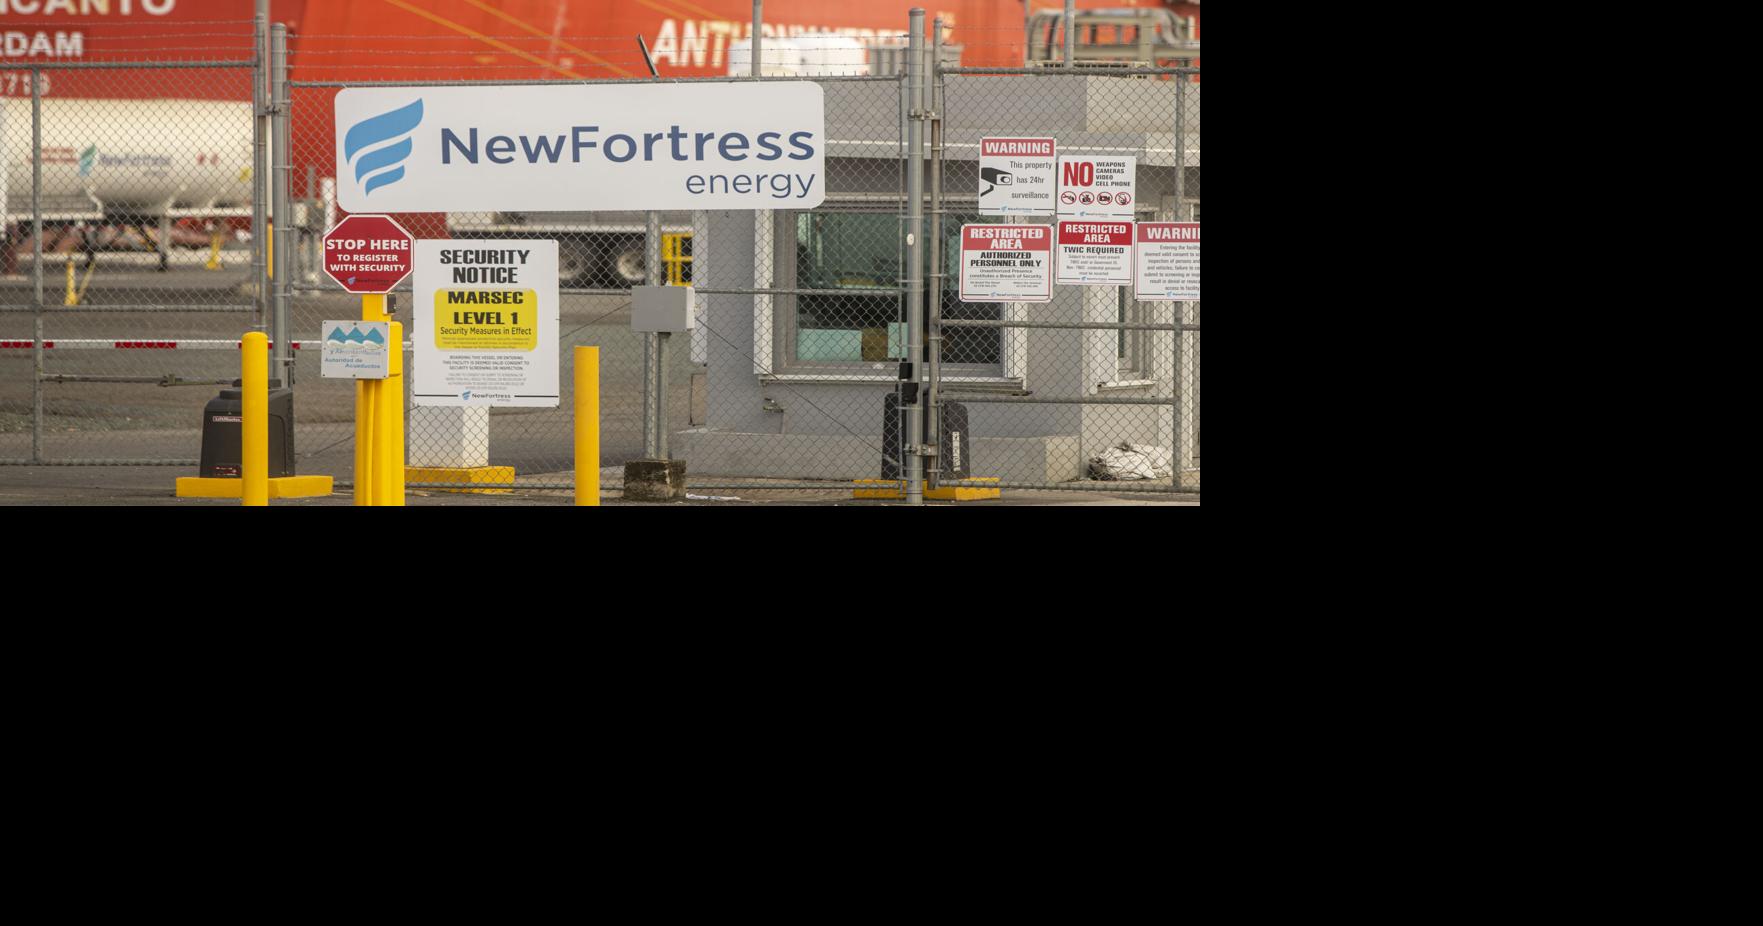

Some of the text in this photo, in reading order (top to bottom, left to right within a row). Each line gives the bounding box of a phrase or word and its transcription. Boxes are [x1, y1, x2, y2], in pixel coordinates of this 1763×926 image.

[0, 31, 84, 57] DAM
[441, 125, 815, 164] NewFortress
[985, 142, 1050, 154] WARNING
[1010, 161, 1052, 170] This property
[1017, 176, 1045, 184] has 24hr
[1063, 162, 1094, 187] NO
[686, 172, 815, 198] energy
[970, 228, 1043, 239] RESTRICTED
[1065, 224, 1126, 234] RESTRICTED
[991, 239, 1023, 249] AREA
[1084, 234, 1111, 243] AREA
[326, 239, 409, 250] STOP HERE
[440, 249, 530, 265] SECURITY
[330, 264, 405, 272] WITH SECURITY
[453, 267, 518, 284] NOTICE
[448, 291, 524, 304] MARSEC
[454, 311, 518, 325] LEVEL 1
[440, 327, 532, 336] Security Measures in Effect
